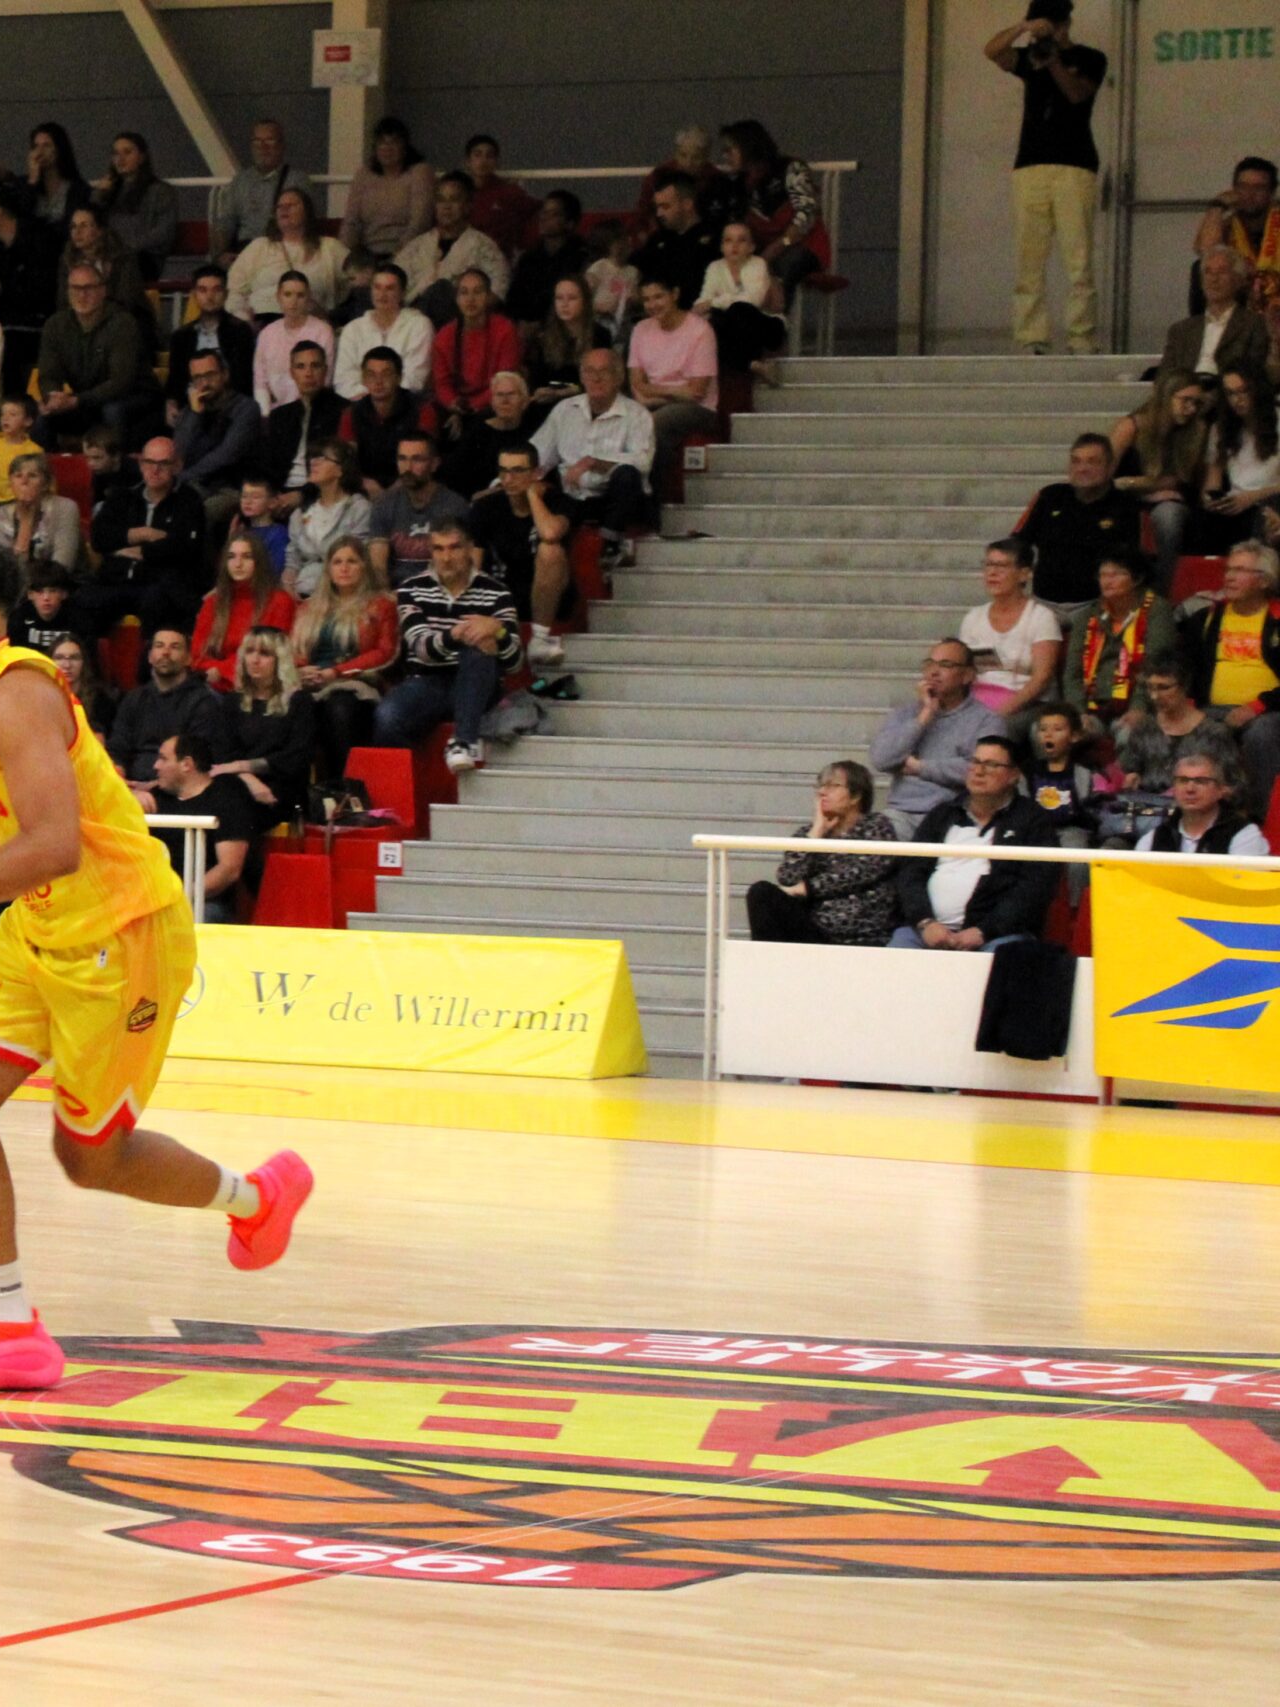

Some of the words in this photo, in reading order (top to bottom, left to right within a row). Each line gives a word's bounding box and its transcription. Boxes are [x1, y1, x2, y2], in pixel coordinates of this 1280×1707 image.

[1154, 27, 1273, 63] SORTIE
[328, 991, 372, 1022] de
[394, 993, 589, 1033] Willermin
[199, 1533, 576, 1582] 1993
